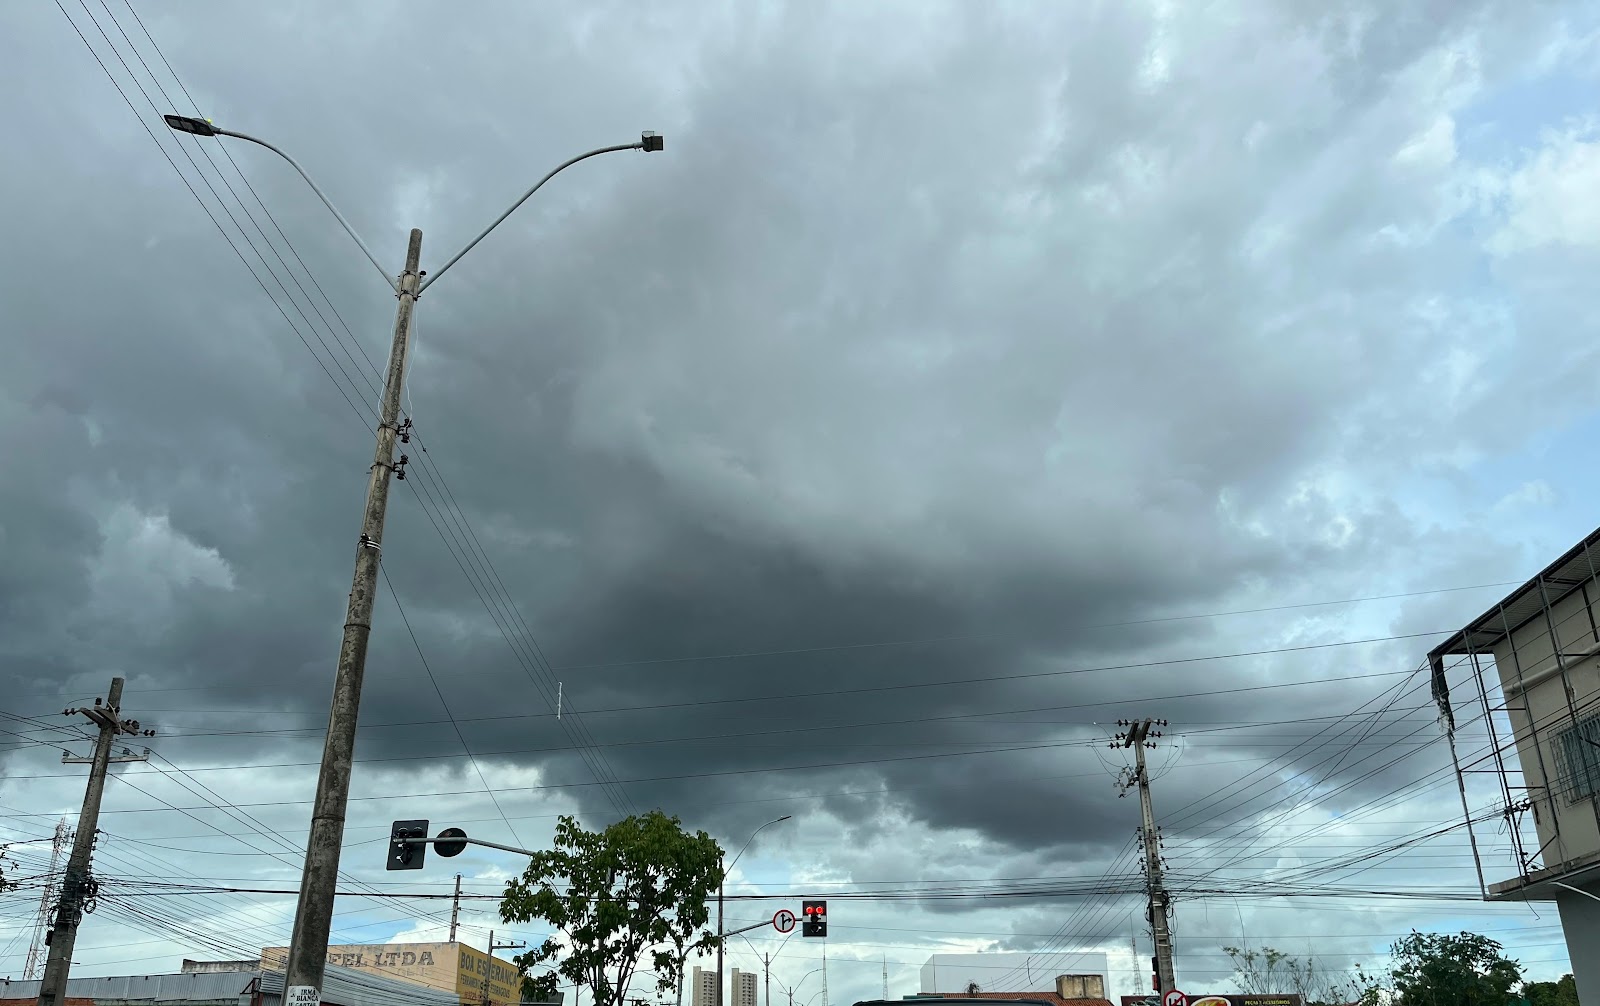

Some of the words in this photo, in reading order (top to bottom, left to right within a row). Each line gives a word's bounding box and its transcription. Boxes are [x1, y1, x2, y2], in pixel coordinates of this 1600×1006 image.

[374, 951, 435, 967] LTDA
[460, 952, 474, 972] BOA
[477, 958, 518, 989] ESERANÇA
